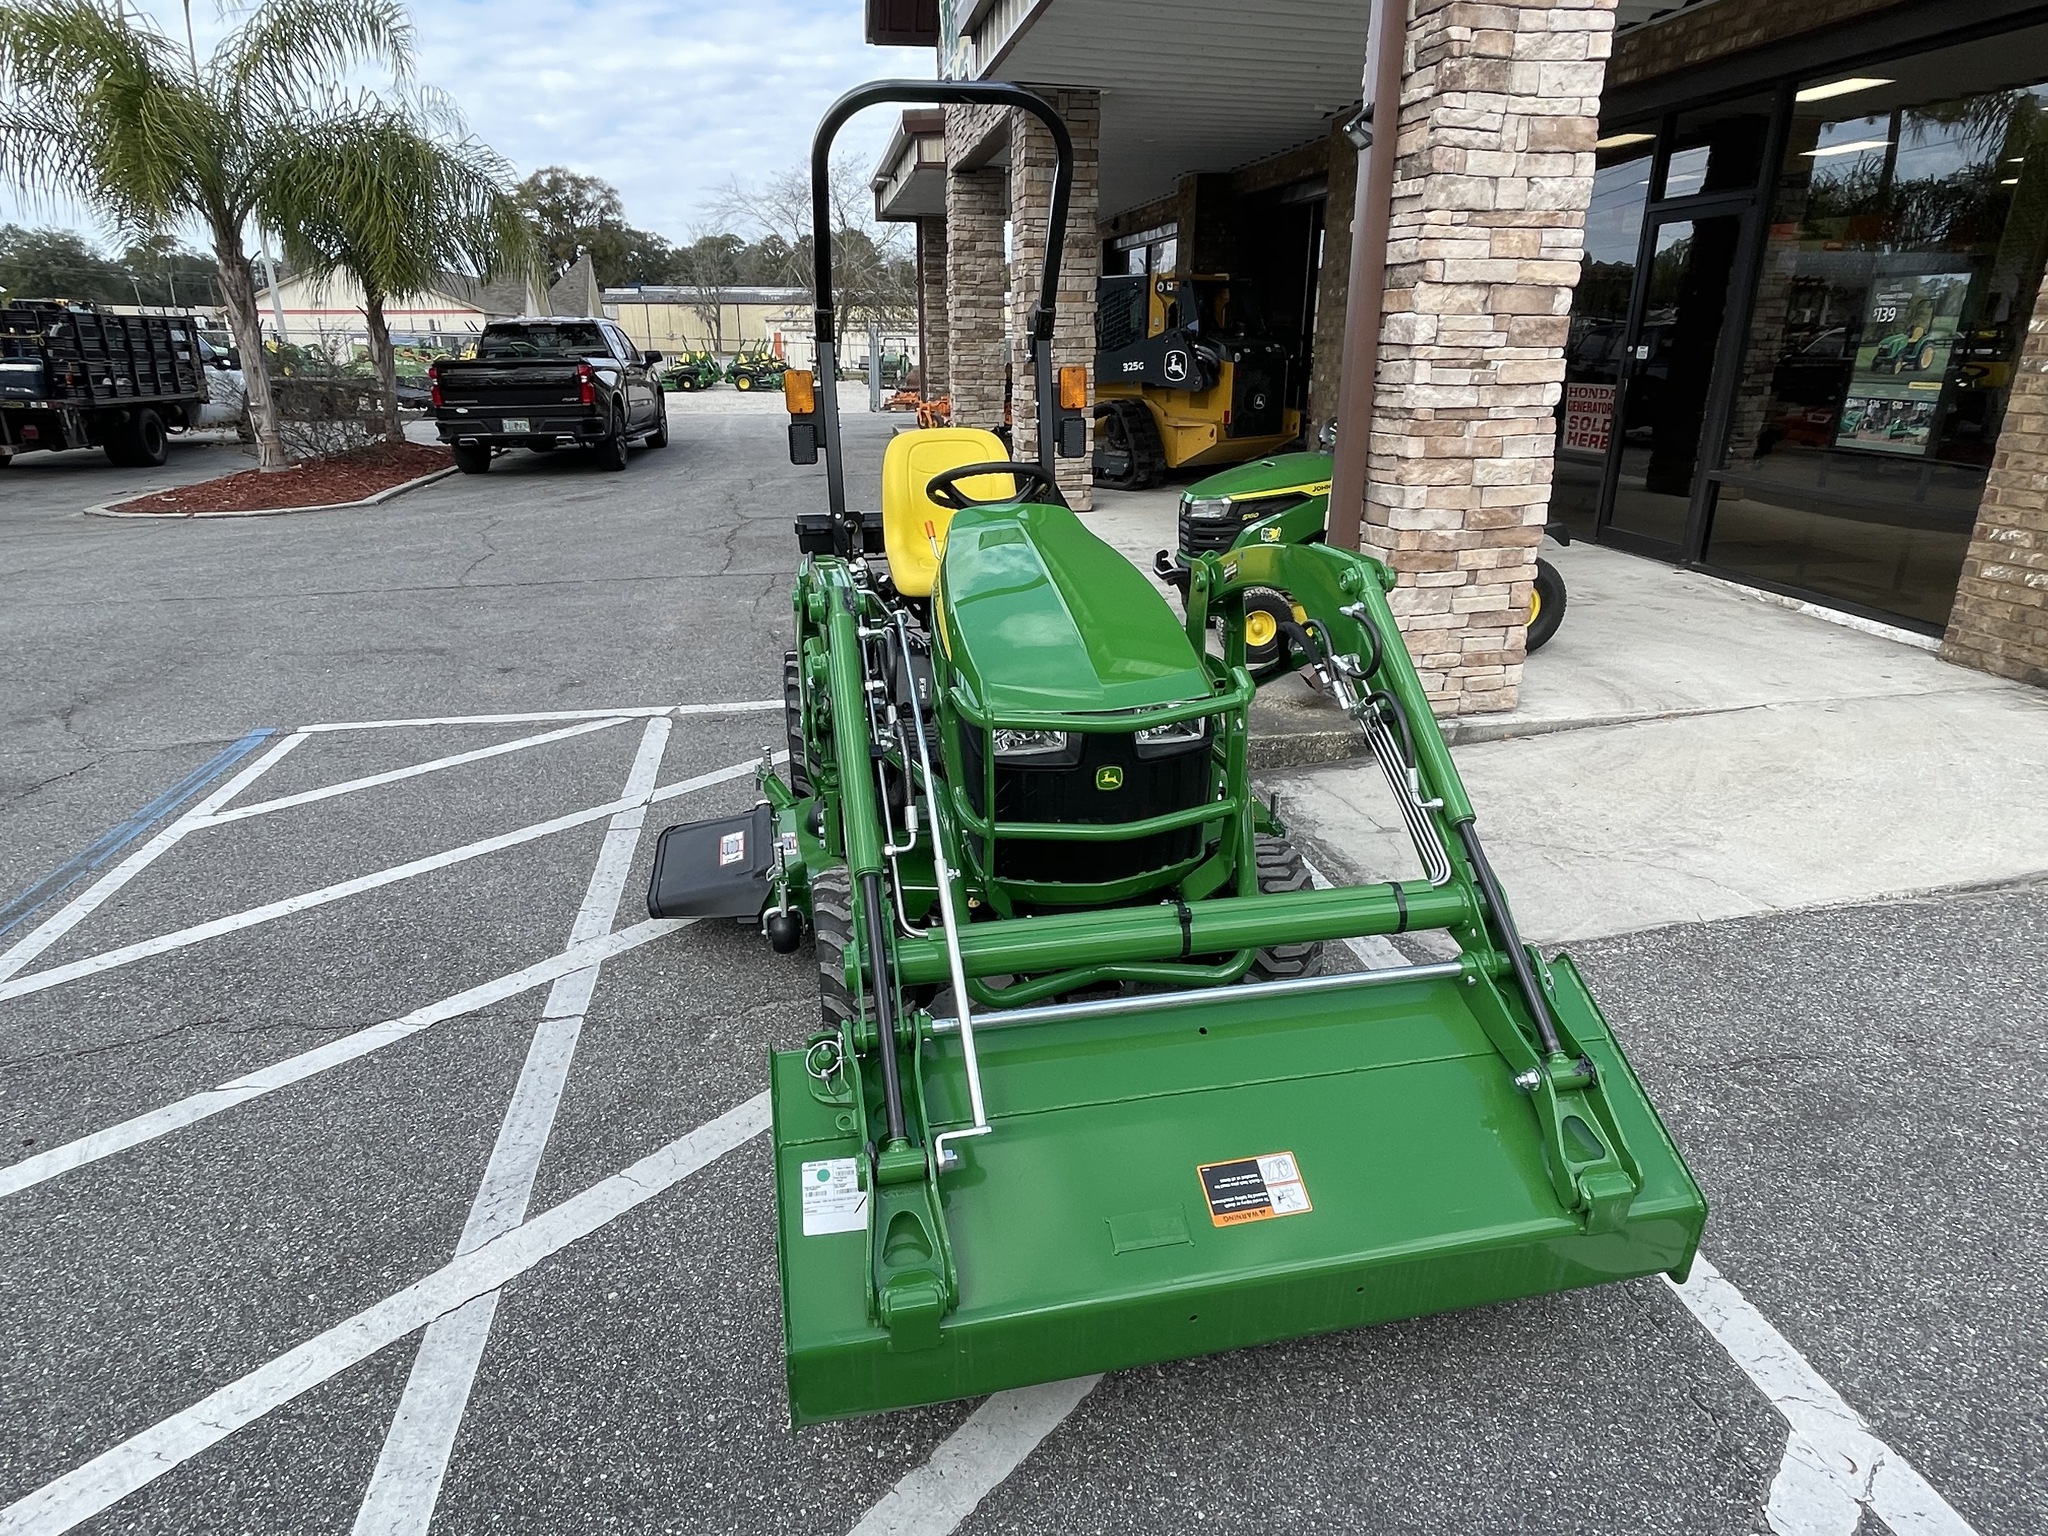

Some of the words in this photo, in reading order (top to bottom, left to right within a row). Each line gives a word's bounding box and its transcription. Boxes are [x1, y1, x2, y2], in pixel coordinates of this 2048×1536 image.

[1873, 307, 1896, 322] $139
[1122, 362, 1144, 372] 325G
[1568, 387, 1616, 399] HONDA
[1568, 415, 1611, 433] SOLD
[1566, 431, 1609, 449] HERE
[1223, 1211, 1259, 1222] WARNING
